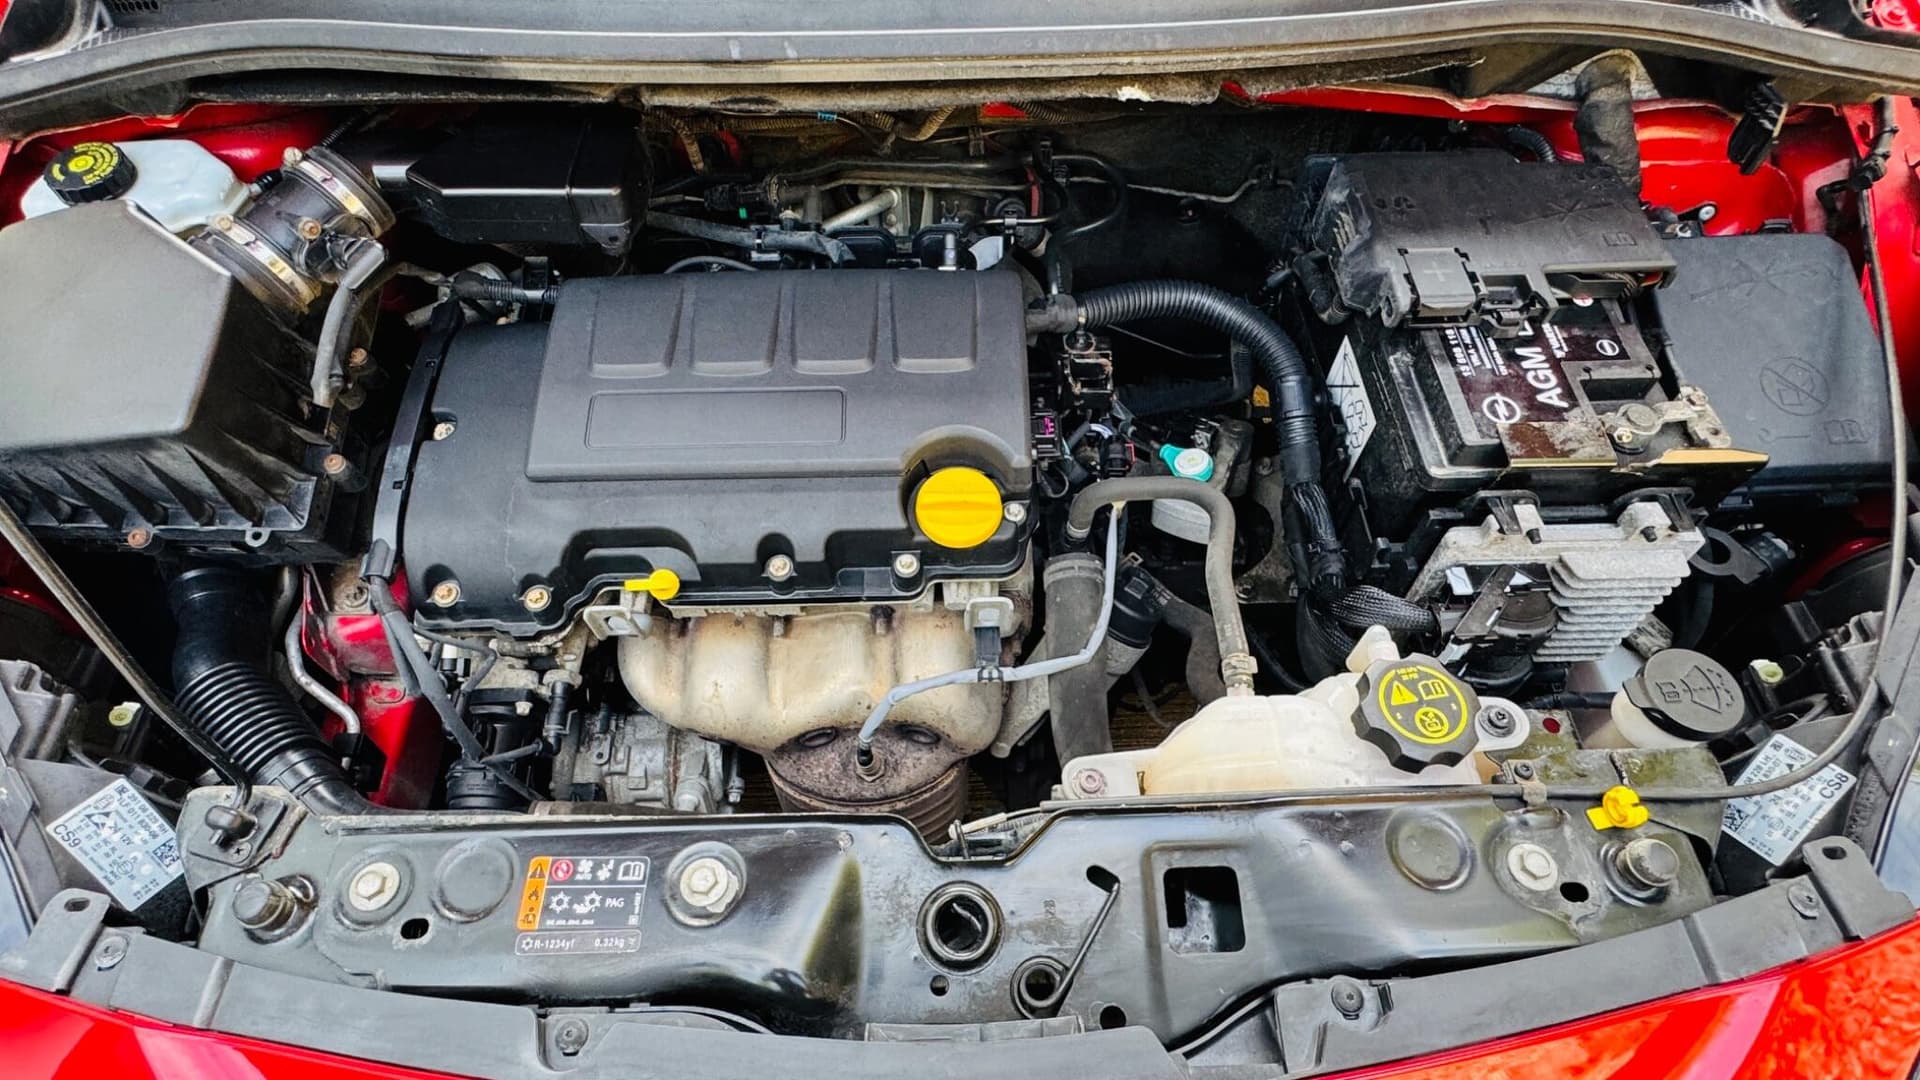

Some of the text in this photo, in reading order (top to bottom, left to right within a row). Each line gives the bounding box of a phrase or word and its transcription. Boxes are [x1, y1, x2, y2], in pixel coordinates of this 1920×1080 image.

[1515, 346, 1569, 408] AGM
[1819, 772, 1849, 799] CS8
[53, 823, 82, 848] CS9
[120, 833, 134, 846] 12V
[605, 898, 625, 908] PAG
[534, 937, 625, 950] R-1234yf 0.32kg
